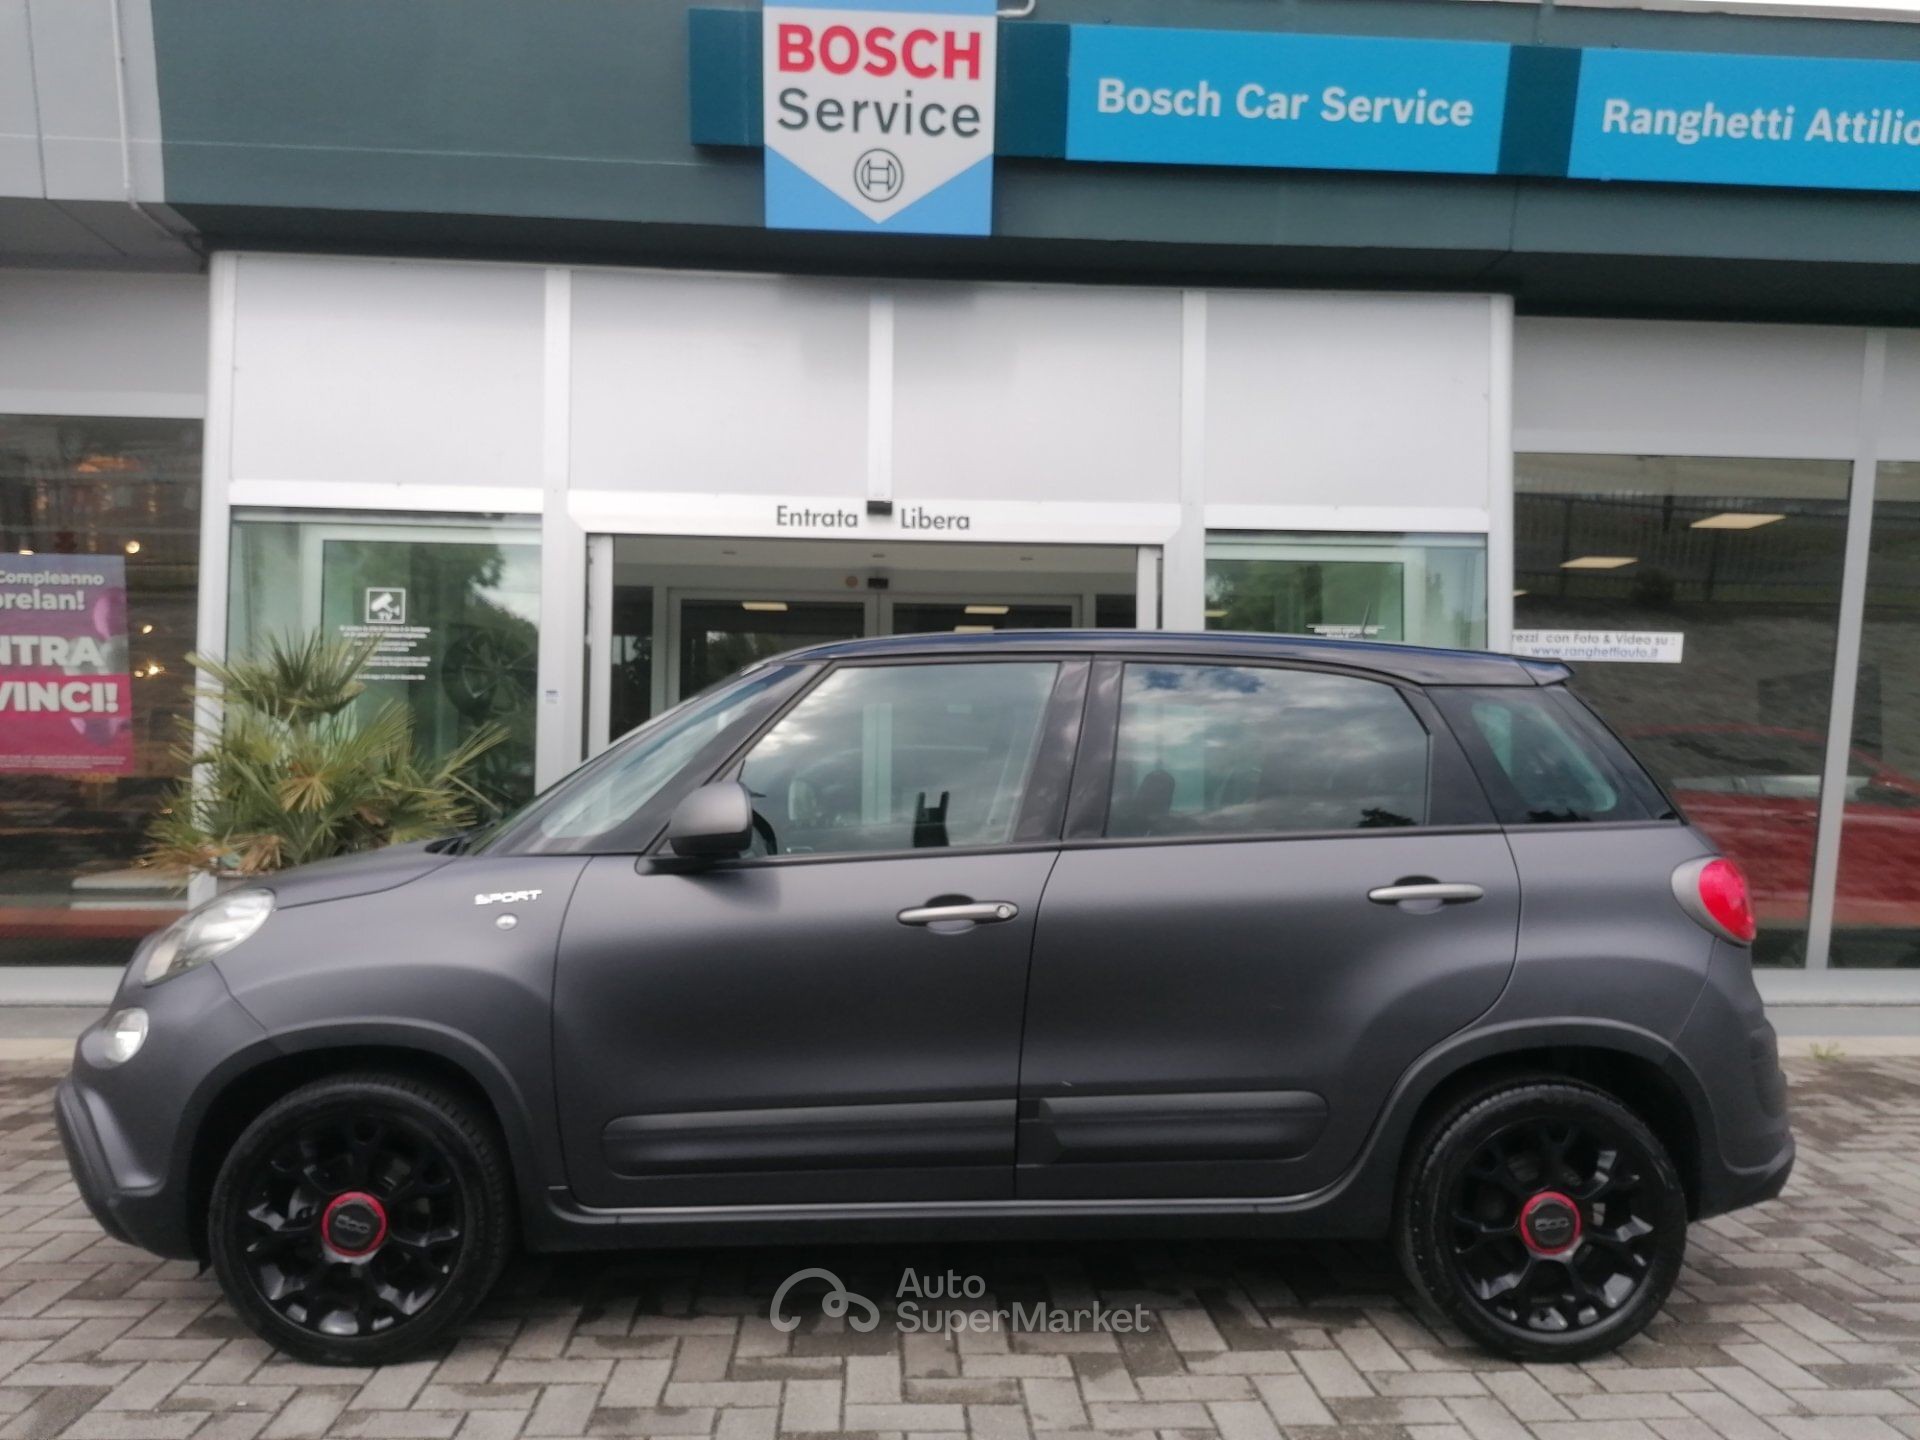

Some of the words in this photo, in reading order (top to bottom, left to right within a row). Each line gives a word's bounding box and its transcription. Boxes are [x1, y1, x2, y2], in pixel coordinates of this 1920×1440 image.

[778, 23, 981, 80] BOSCH
[777, 87, 981, 138] Service
[1097, 78, 1221, 117] Bosch
[1236, 83, 1309, 120] Car
[1320, 86, 1473, 126] Service
[1602, 99, 1796, 145] Ranghetti
[1804, 108, 1920, 146] Attilio
[776, 505, 858, 527] Entrata
[901, 507, 970, 530] Libera
[0, 589, 85, 611] relan!
[1546, 635, 1570, 644] con
[1573, 633, 1599, 645] Foto
[1603, 634, 1610, 645] &
[1616, 634, 1651, 645] Video
[475, 890, 542, 905] SPORT
